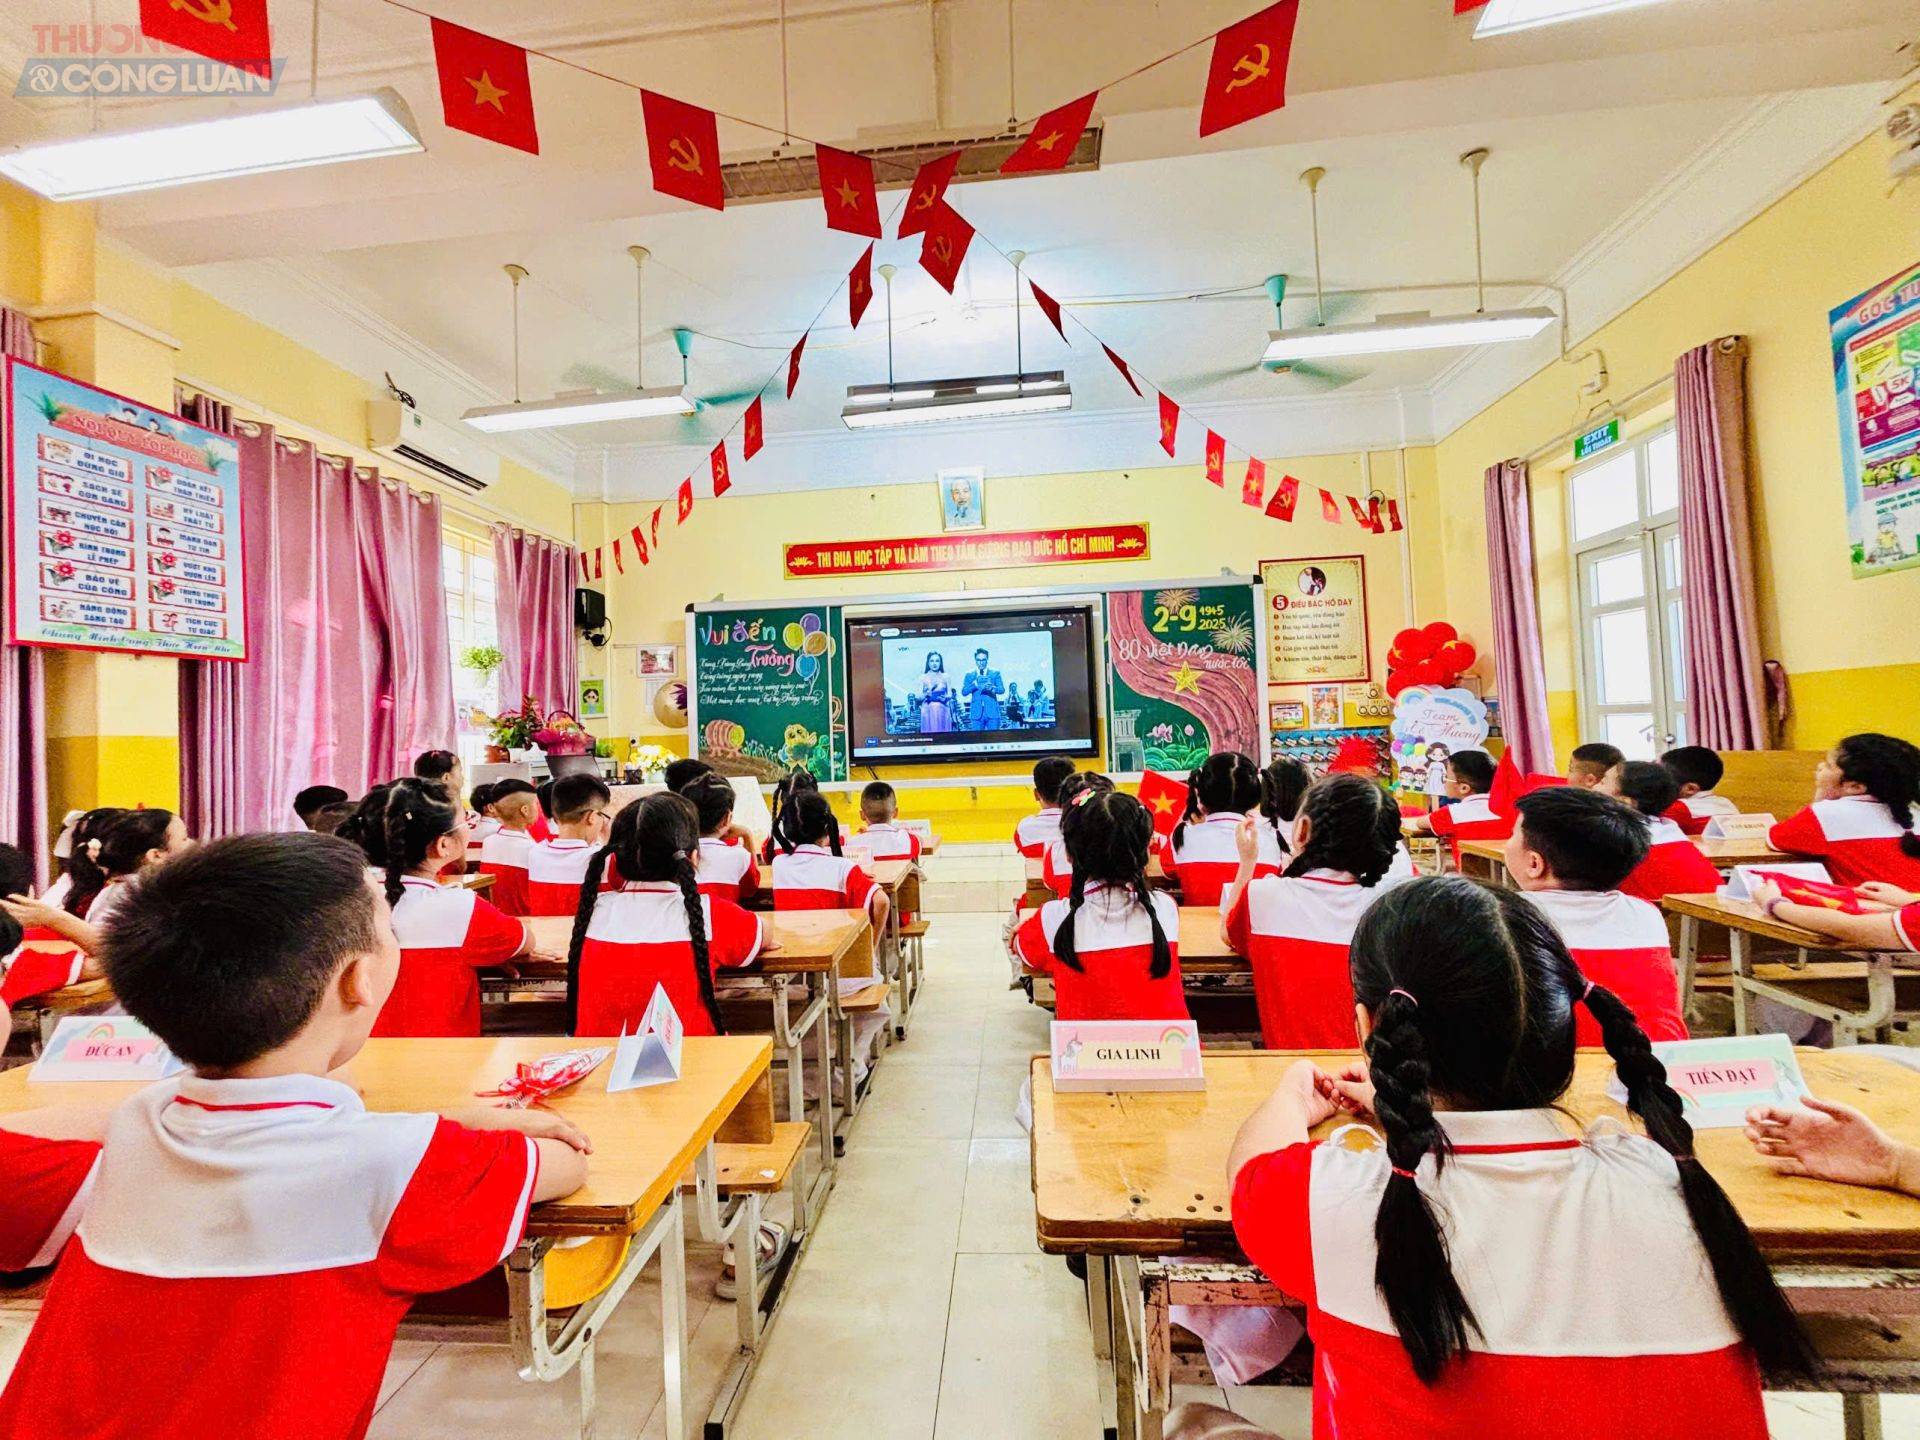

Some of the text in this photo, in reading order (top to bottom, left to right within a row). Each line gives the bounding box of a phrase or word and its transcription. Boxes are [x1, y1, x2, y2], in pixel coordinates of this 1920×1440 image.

[1584, 425, 1609, 446] EXIT
[816, 551, 831, 569] THI
[854, 549, 873, 570] HỌC
[874, 545, 893, 569] TẬP
[894, 544, 907, 565] VÀ
[908, 543, 929, 564] LÀM
[1070, 533, 1087, 555] CHÍ
[1089, 535, 1115, 553] MINH
[1276, 596, 1285, 608] 5
[1200, 604, 1225, 616] 1945
[1152, 605, 1197, 632] 2-9
[1199, 617, 1226, 631] 2025
[700, 615, 730, 646] Vui
[1119, 639, 1140, 660] 80
[1423, 709, 1459, 721] Team
[114, 1046, 134, 1057] AN
[1097, 1049, 1160, 1060] GIA LINH
